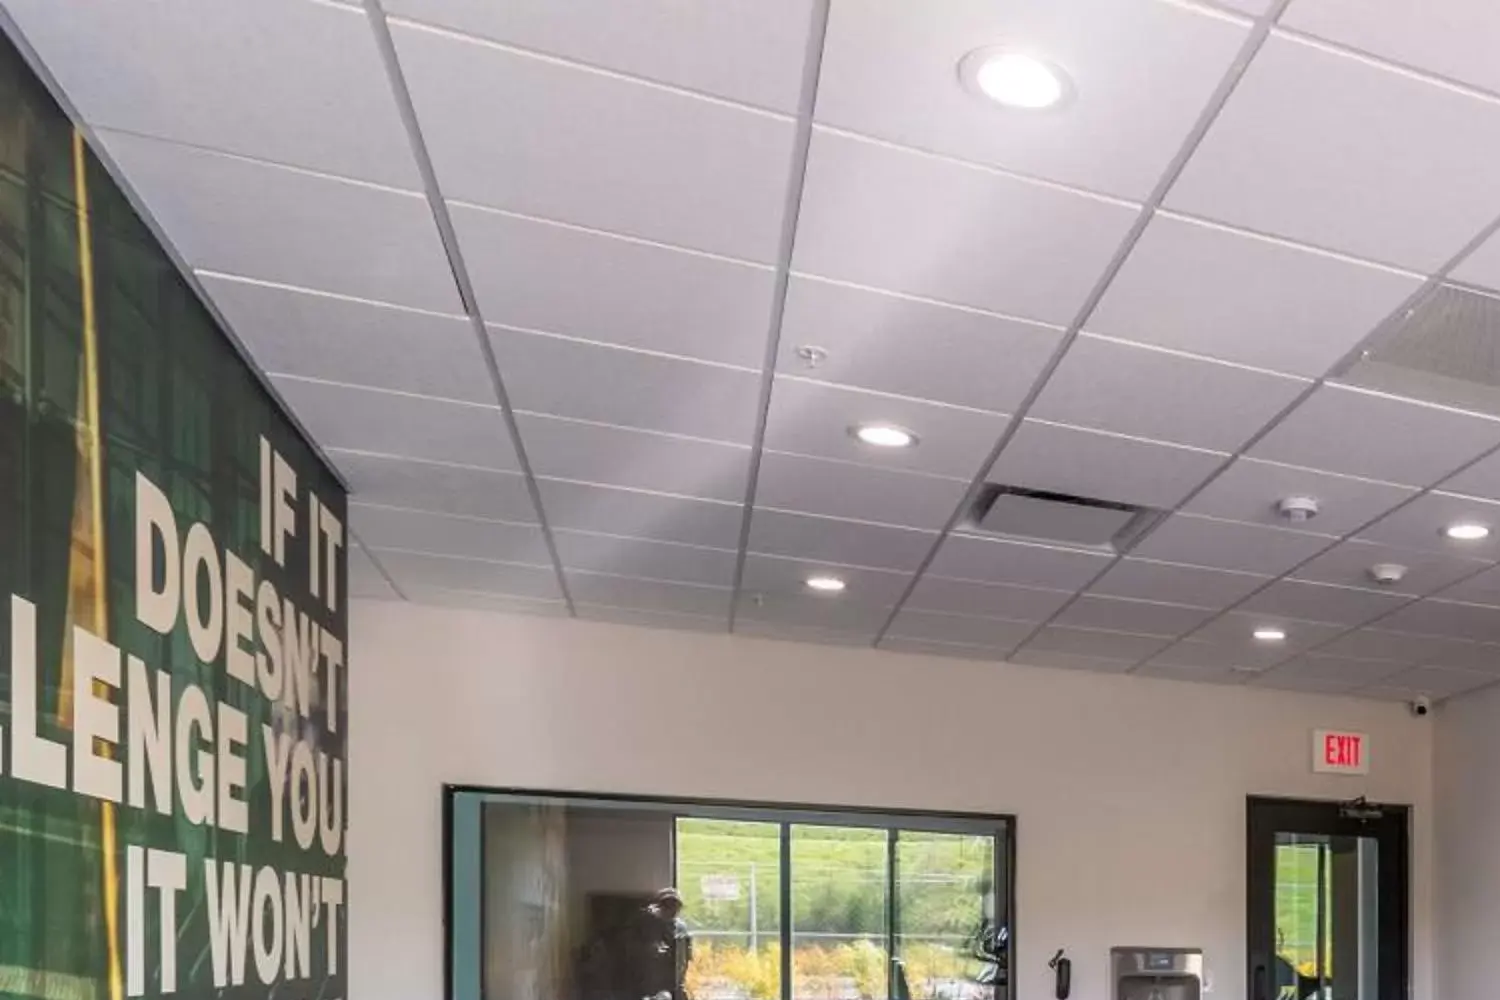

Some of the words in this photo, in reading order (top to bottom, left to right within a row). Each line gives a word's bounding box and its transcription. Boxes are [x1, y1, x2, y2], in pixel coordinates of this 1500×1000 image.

[136, 470, 342, 734] DOESN'T
[260, 434, 297, 567] IF
[310, 491, 342, 612] IT
[0, 593, 249, 833] LENGE
[262, 723, 342, 856] YOU
[1326, 735, 1360, 767] EXIT
[127, 845, 187, 996] IT
[204, 857, 343, 988] WON'T
